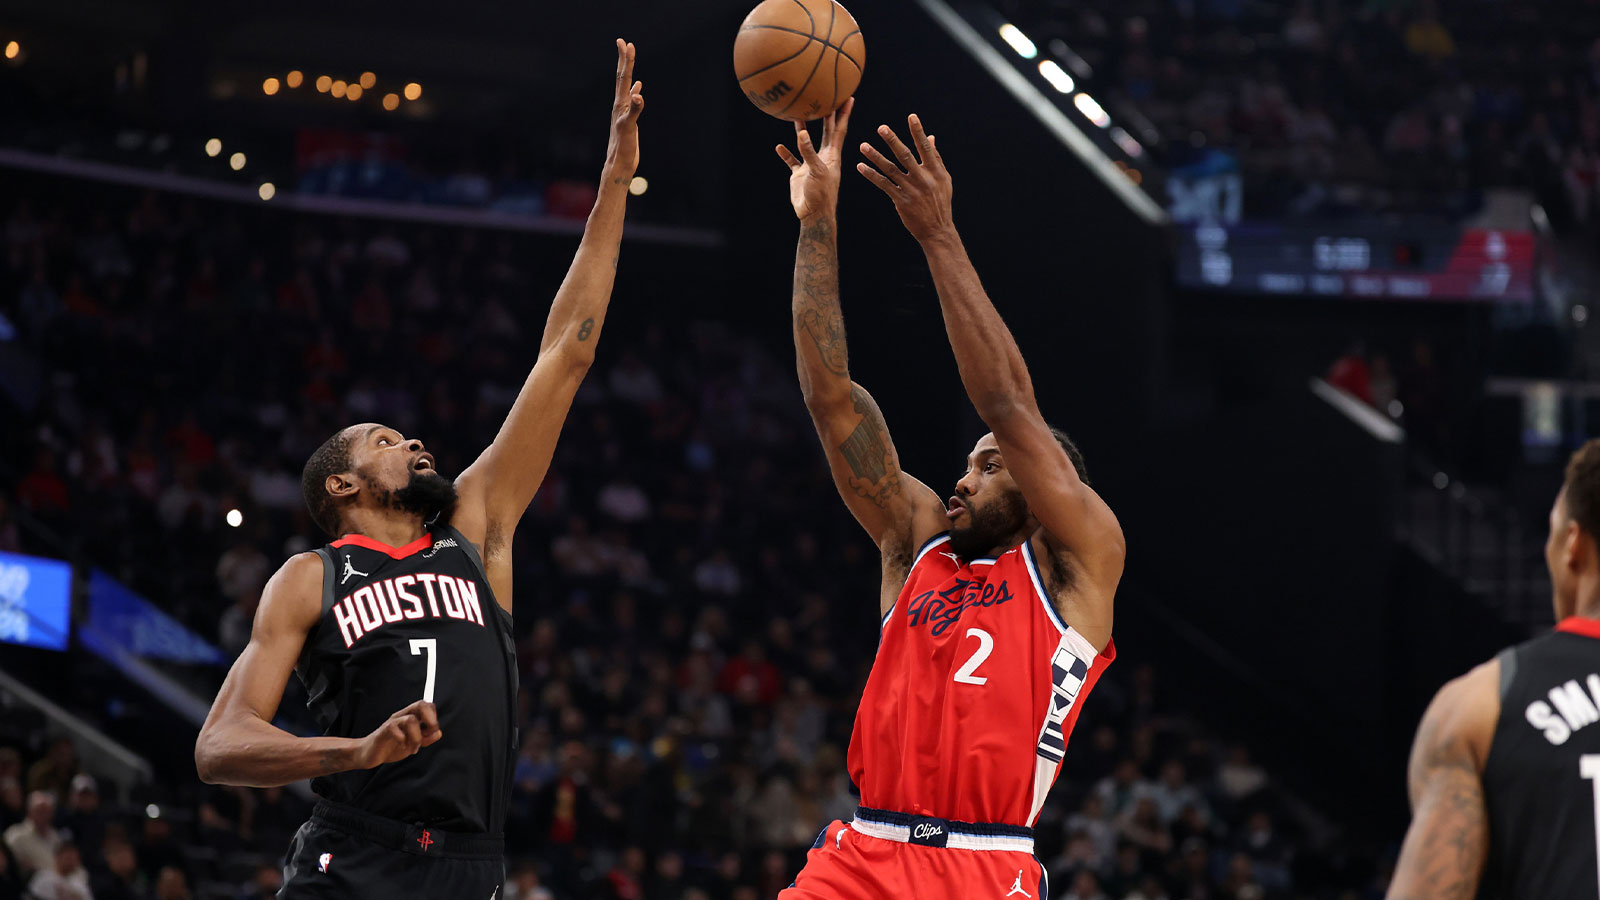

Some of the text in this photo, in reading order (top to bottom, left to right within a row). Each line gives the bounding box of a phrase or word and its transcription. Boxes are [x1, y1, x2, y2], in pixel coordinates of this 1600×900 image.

[332, 572, 485, 649] HOUSTON
[408, 639, 437, 703] 7
[953, 628, 994, 686] 2
[914, 822, 943, 840] Clips
